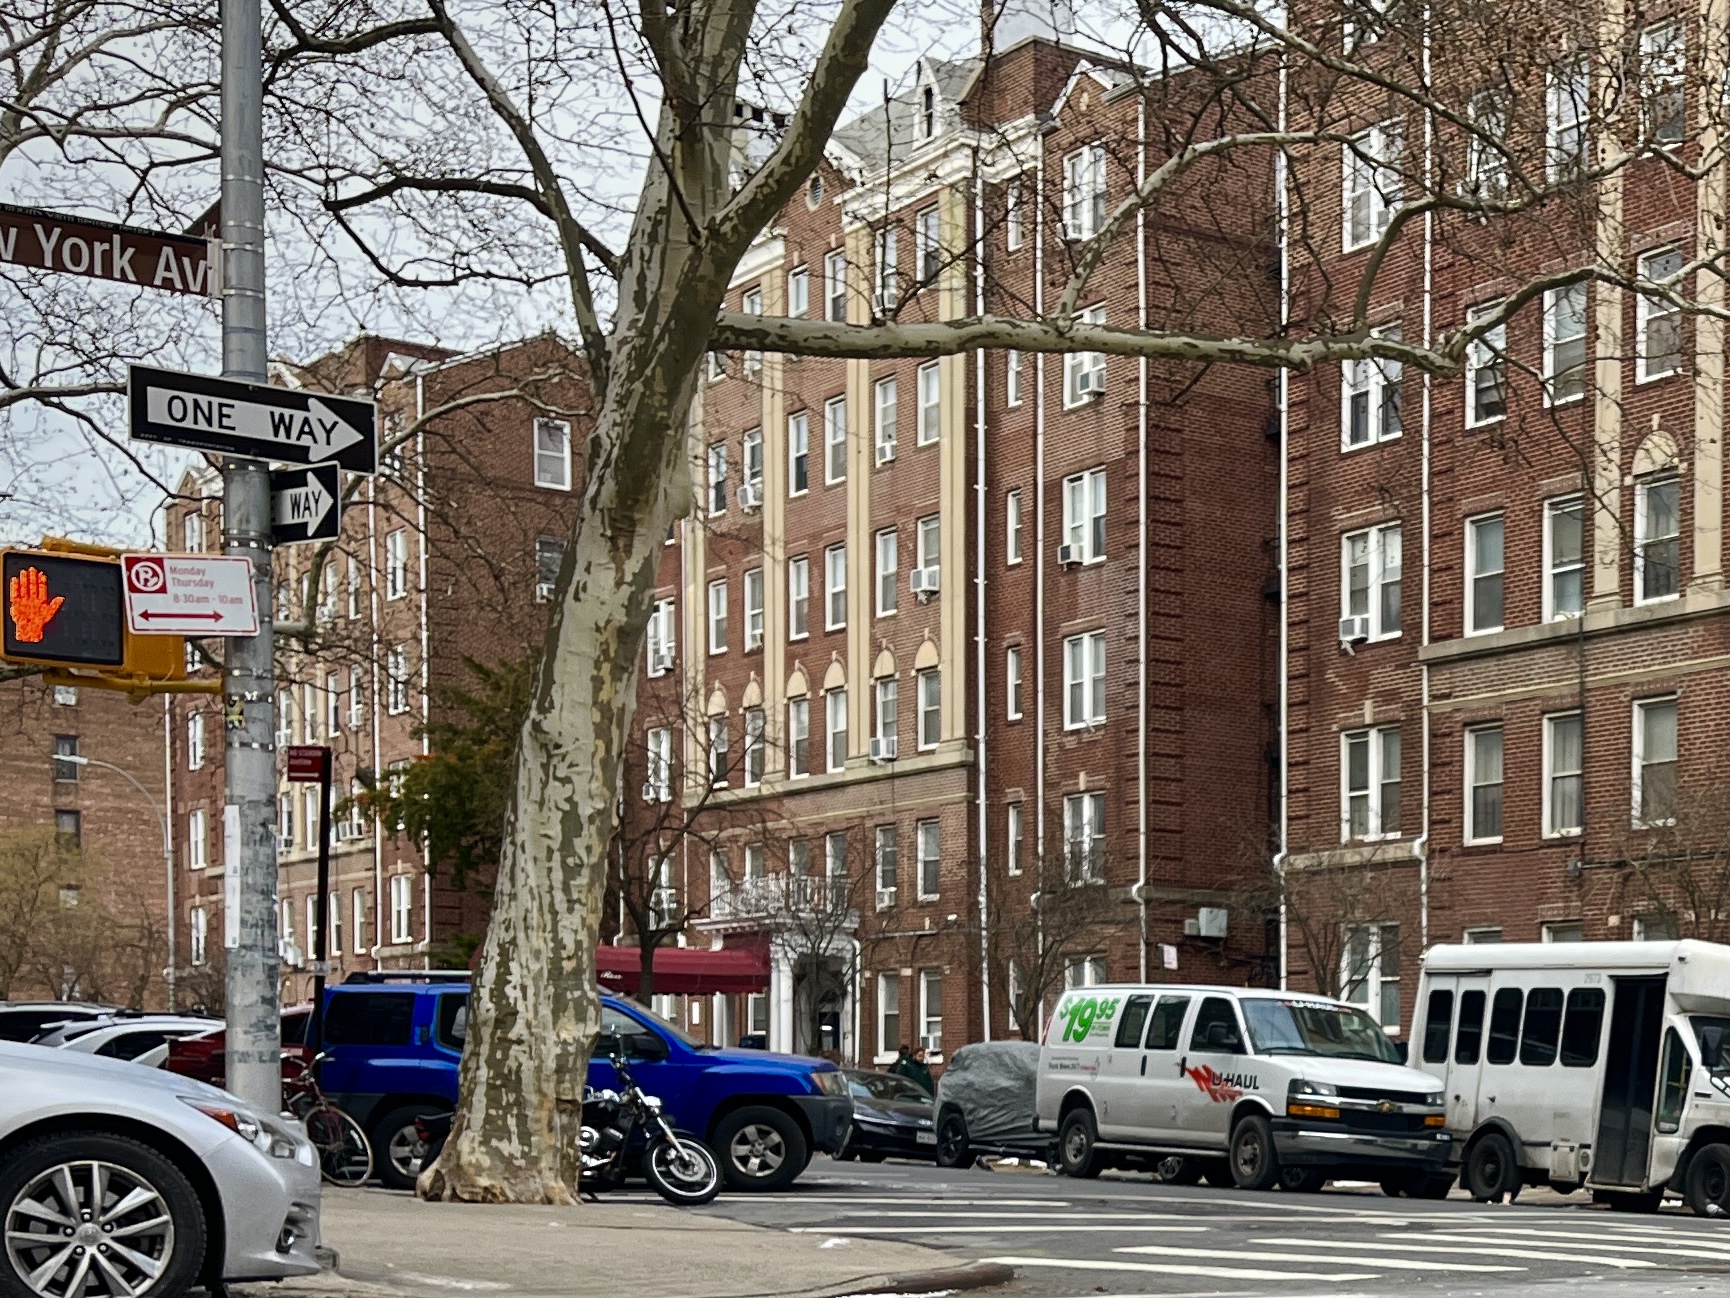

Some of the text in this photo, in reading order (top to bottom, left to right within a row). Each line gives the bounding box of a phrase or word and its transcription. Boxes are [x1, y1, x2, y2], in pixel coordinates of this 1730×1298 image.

[33, 223, 137, 282] York
[153, 246, 207, 293] Av
[167, 395, 236, 431] ONE
[269, 410, 338, 446] WAY
[290, 489, 322, 520] WAY
[169, 566, 206, 576] Monday
[172, 577, 214, 589] Thursday
